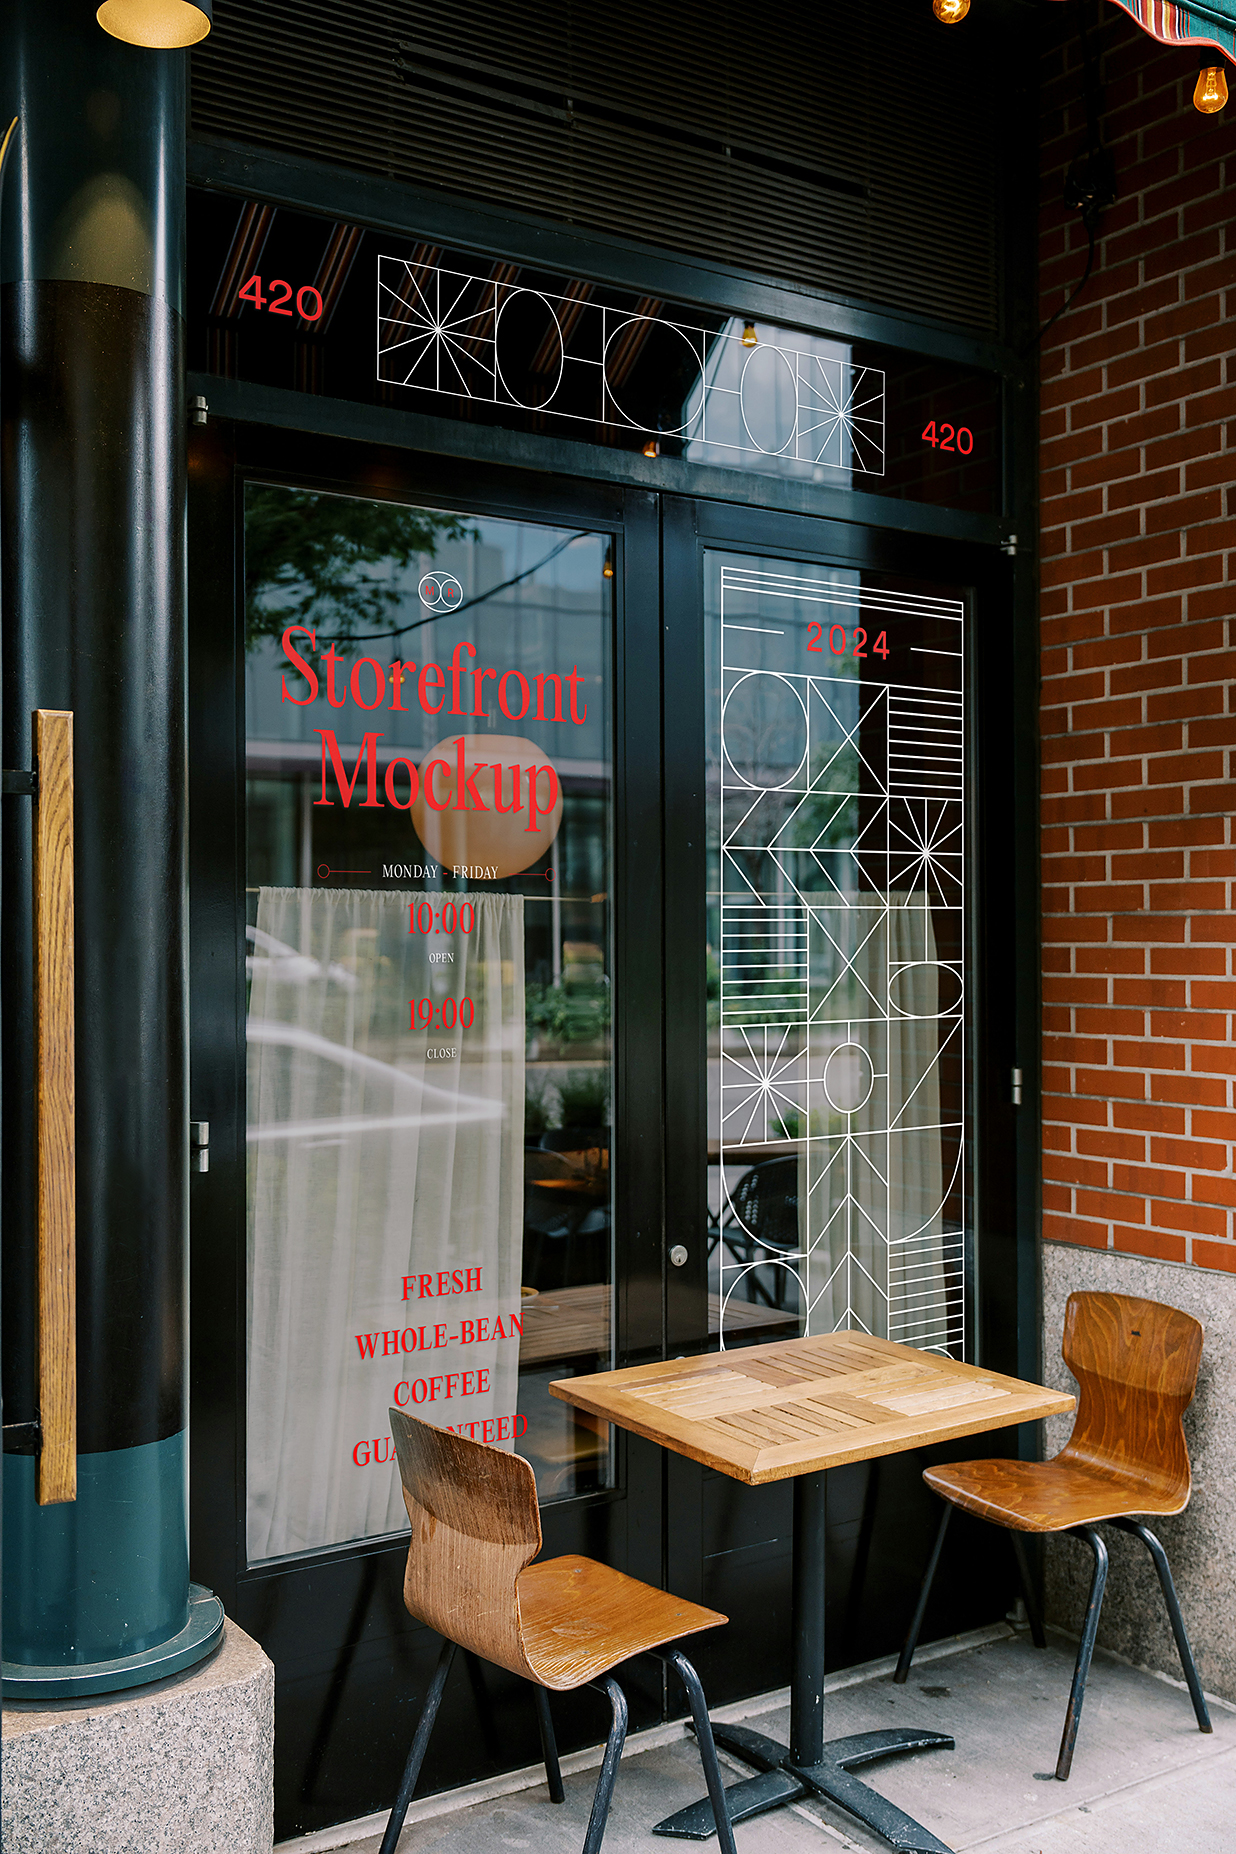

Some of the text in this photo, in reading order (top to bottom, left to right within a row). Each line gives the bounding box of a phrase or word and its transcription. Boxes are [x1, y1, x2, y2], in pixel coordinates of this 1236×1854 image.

[238, 274, 324, 322] 420
[921, 420, 974, 455] 420
[425, 585, 455, 598] M R
[806, 621, 890, 661] 2024
[281, 625, 588, 725] Storefront
[312, 728, 559, 833] Mockup
[382, 863, 439, 879] MONDAY
[452, 865, 499, 880] FRIDAY
[407, 901, 475, 935] 10:00
[428, 952, 455, 964] OPEN
[407, 996, 475, 1031] 19:00
[426, 1047, 457, 1060] CLOSE
[400, 1266, 483, 1302] FRESH
[354, 1311, 526, 1360] WHOLE-BEAN
[393, 1368, 491, 1407] COFFEE
